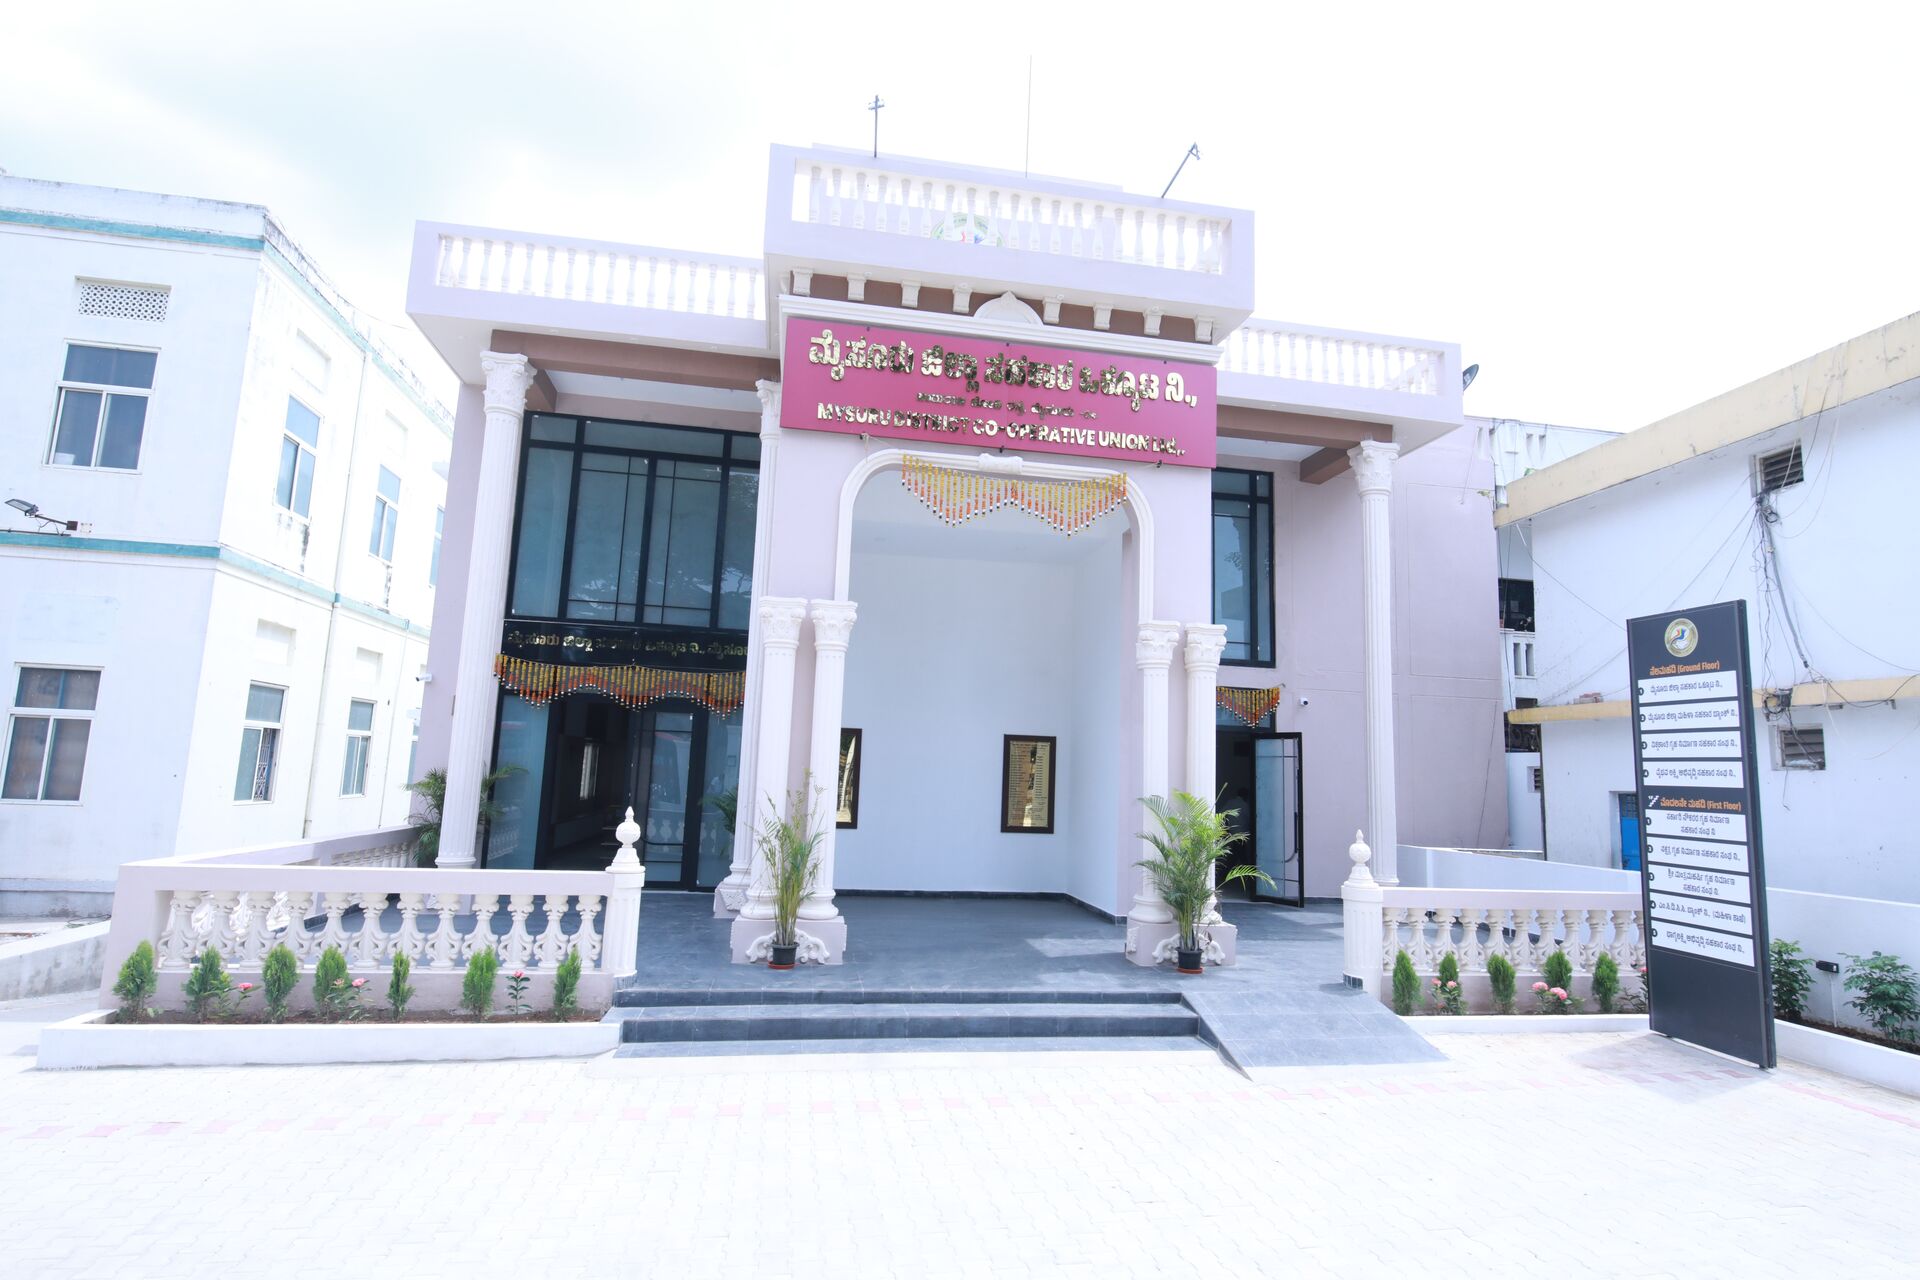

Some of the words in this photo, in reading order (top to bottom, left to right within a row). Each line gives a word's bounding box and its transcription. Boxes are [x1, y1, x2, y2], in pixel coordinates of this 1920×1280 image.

[808, 329, 915, 381] ಮೈಸೂರು
[921, 345, 979, 392] ಜಿಲ್ಲಾ
[984, 352, 1074, 391] ಸಹಕಾರ
[1079, 361, 1159, 411] ಒಕ್ಕೂಟ
[817, 402, 892, 426] MYSURU
[893, 409, 970, 434] DISTRICT
[972, 418, 1096, 447] CO-OPERATIVE
[1098, 432, 1150, 451] UNION
[563, 635, 593, 652] ಜಿಲ್ಲಾ
